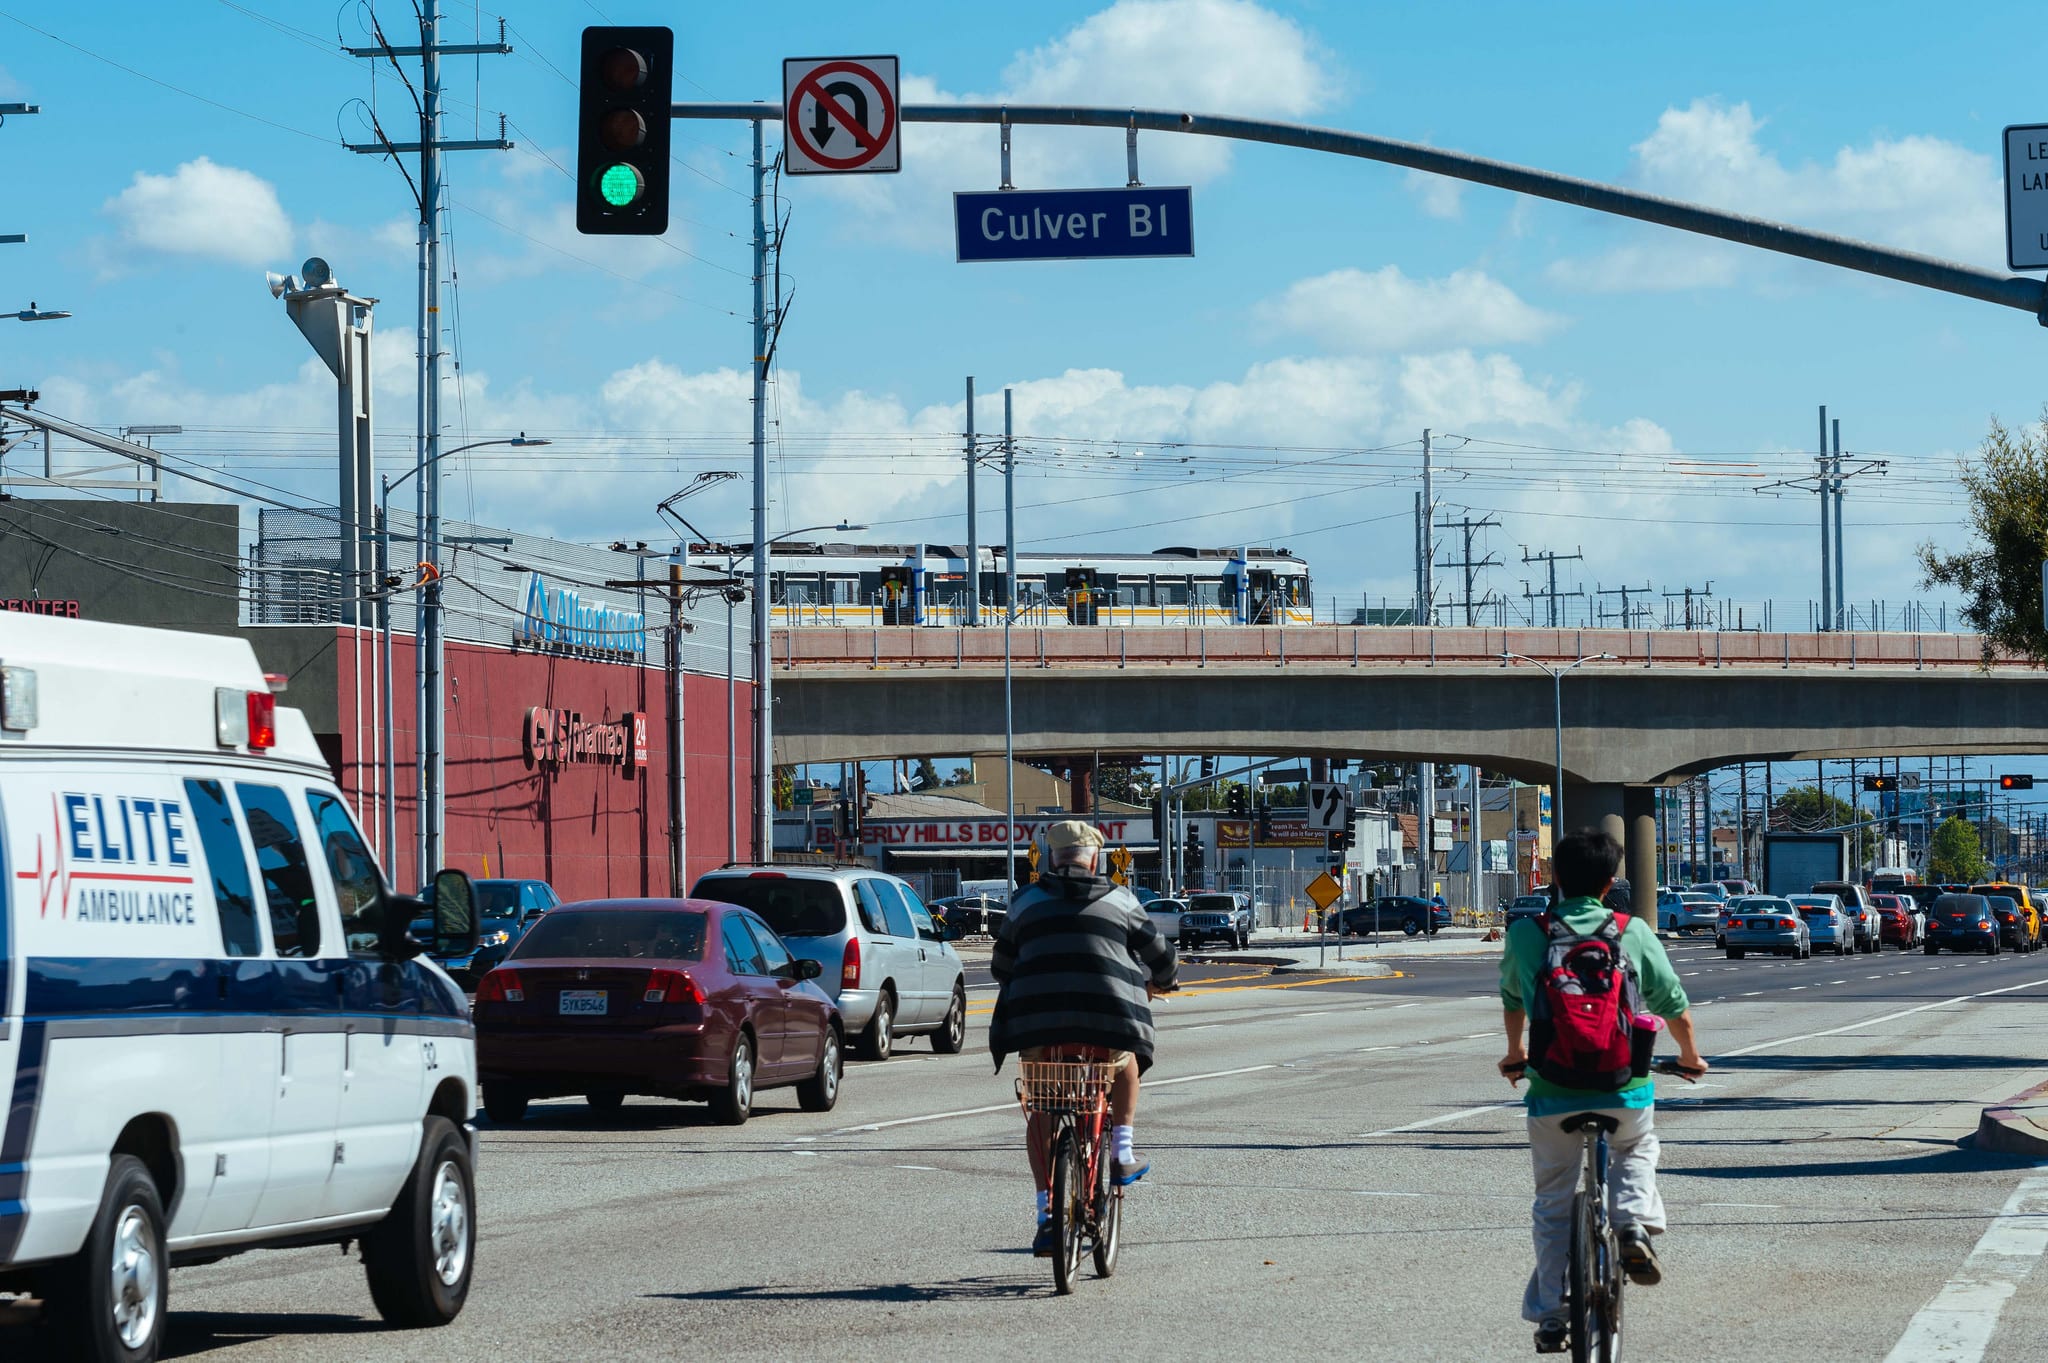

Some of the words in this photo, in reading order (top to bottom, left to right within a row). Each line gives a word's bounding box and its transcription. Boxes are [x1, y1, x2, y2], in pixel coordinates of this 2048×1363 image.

[981, 206, 1107, 241] Culver
[1128, 203, 1167, 237] Bl
[555, 587, 645, 654] Albertsons
[530, 706, 628, 766] CVS/pharmacy
[635, 718, 647, 747] 24
[634, 749, 648, 761] HOURS
[62, 791, 191, 868] ELITE
[914, 823, 973, 843] HILLS
[978, 821, 1038, 842] BODY
[77, 887, 195, 925] AMBULANCE
